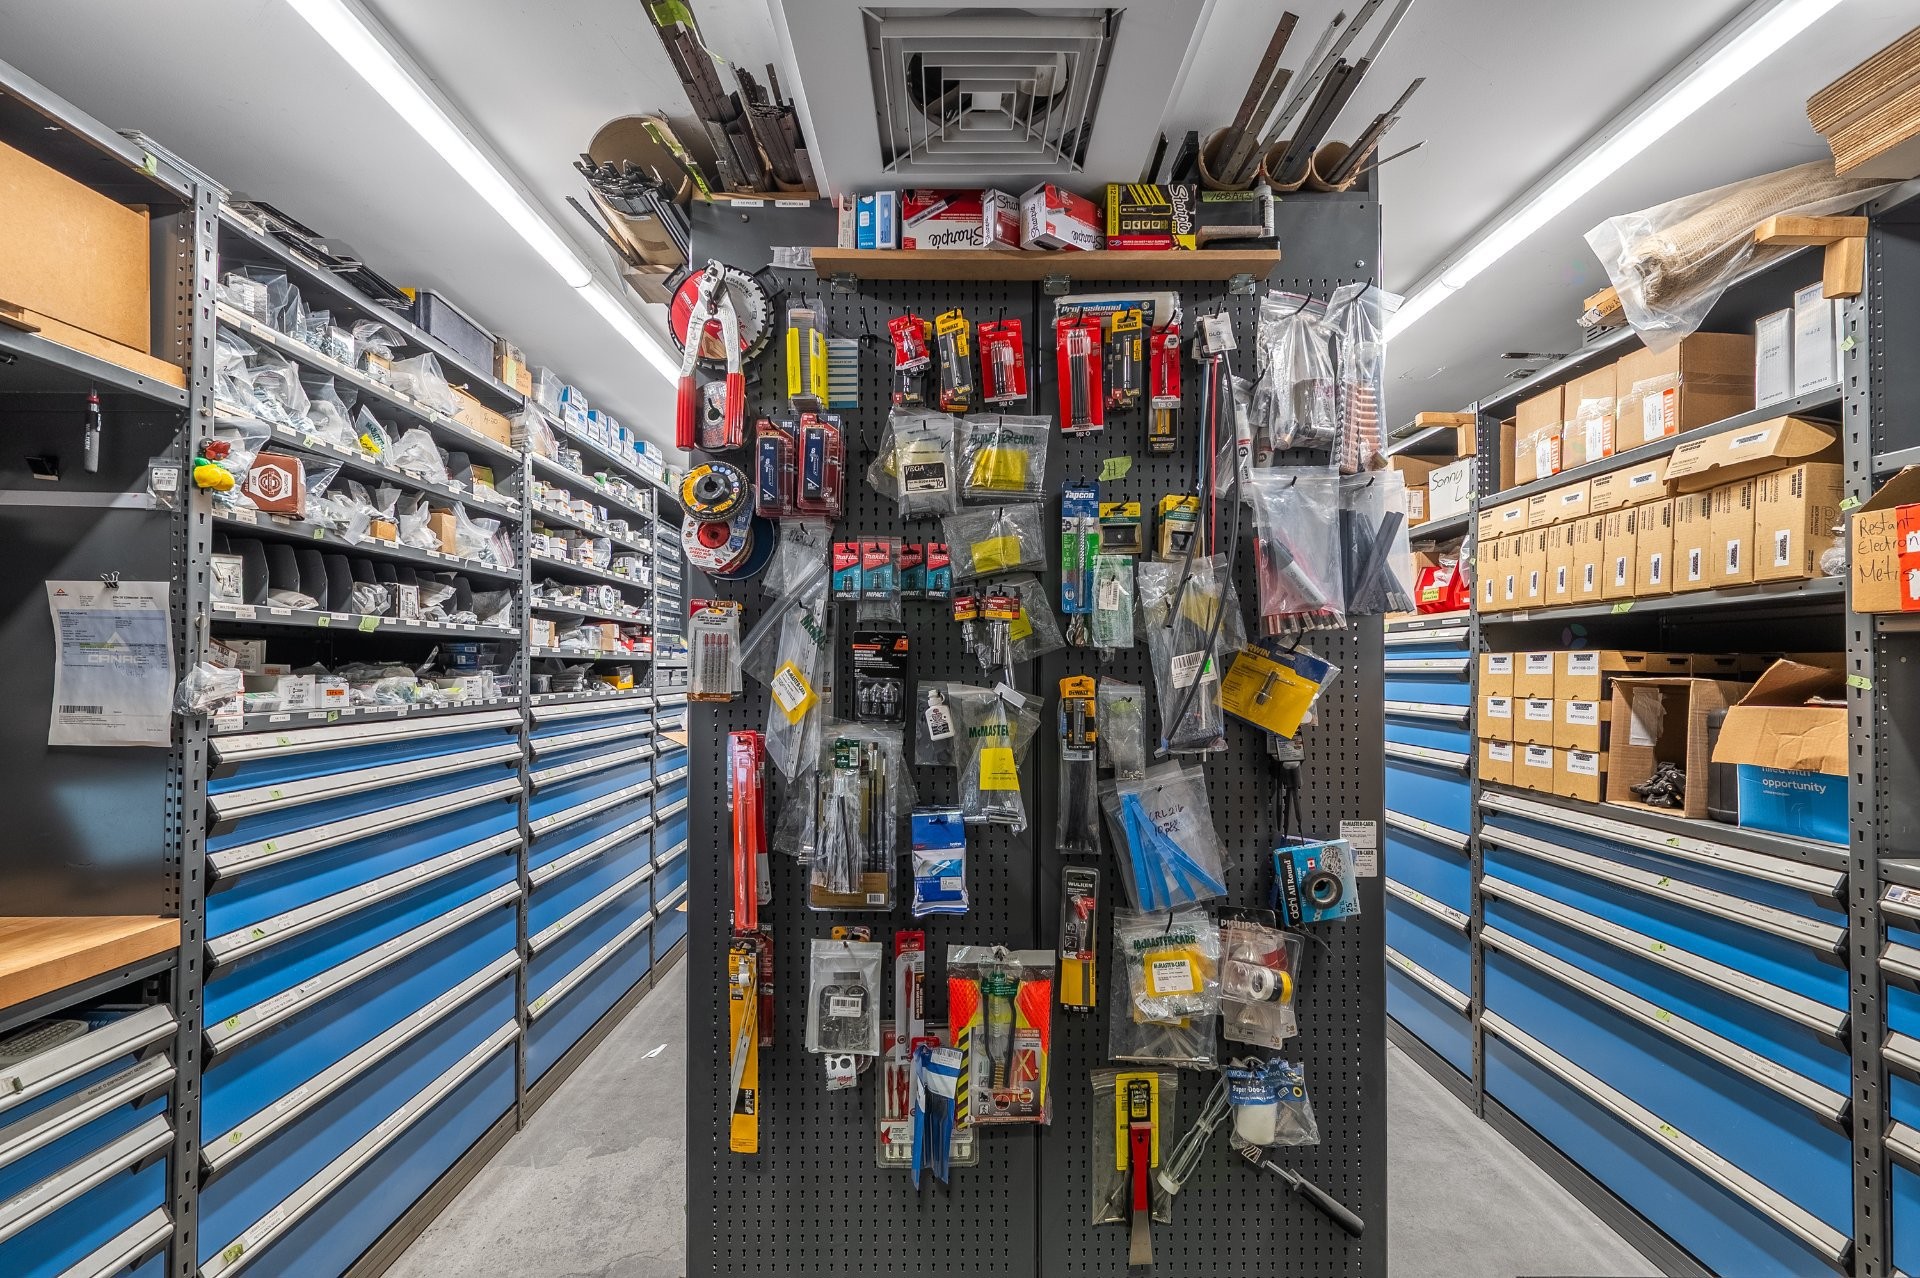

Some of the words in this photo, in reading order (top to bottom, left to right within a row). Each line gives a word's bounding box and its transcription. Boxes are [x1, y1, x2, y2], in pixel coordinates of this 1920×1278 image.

[1168, 184, 1192, 234] Sharpie
[1031, 203, 1039, 239] Sharpie
[929, 226, 984, 249] Sharpie
[1071, 230, 1104, 249] Sharpie
[1664, 394, 1674, 431] ULINE
[1603, 418, 1611, 450] ULINE
[1551, 440, 1559, 469] ULINE
[905, 464, 924, 473] VEGA
[1431, 470, 1463, 491] Sonny
[1065, 490, 1094, 499] Tapcon
[1859, 510, 1914, 537] Restant
[1247, 643, 1270, 658] RWIN
[1762, 777, 1827, 794] opportunity
[1284, 860, 1294, 886] Round
[1288, 887, 1296, 898] All
[1133, 935, 1197, 949] McMASTER-CARR
[1232, 1085, 1247, 1094] Super
